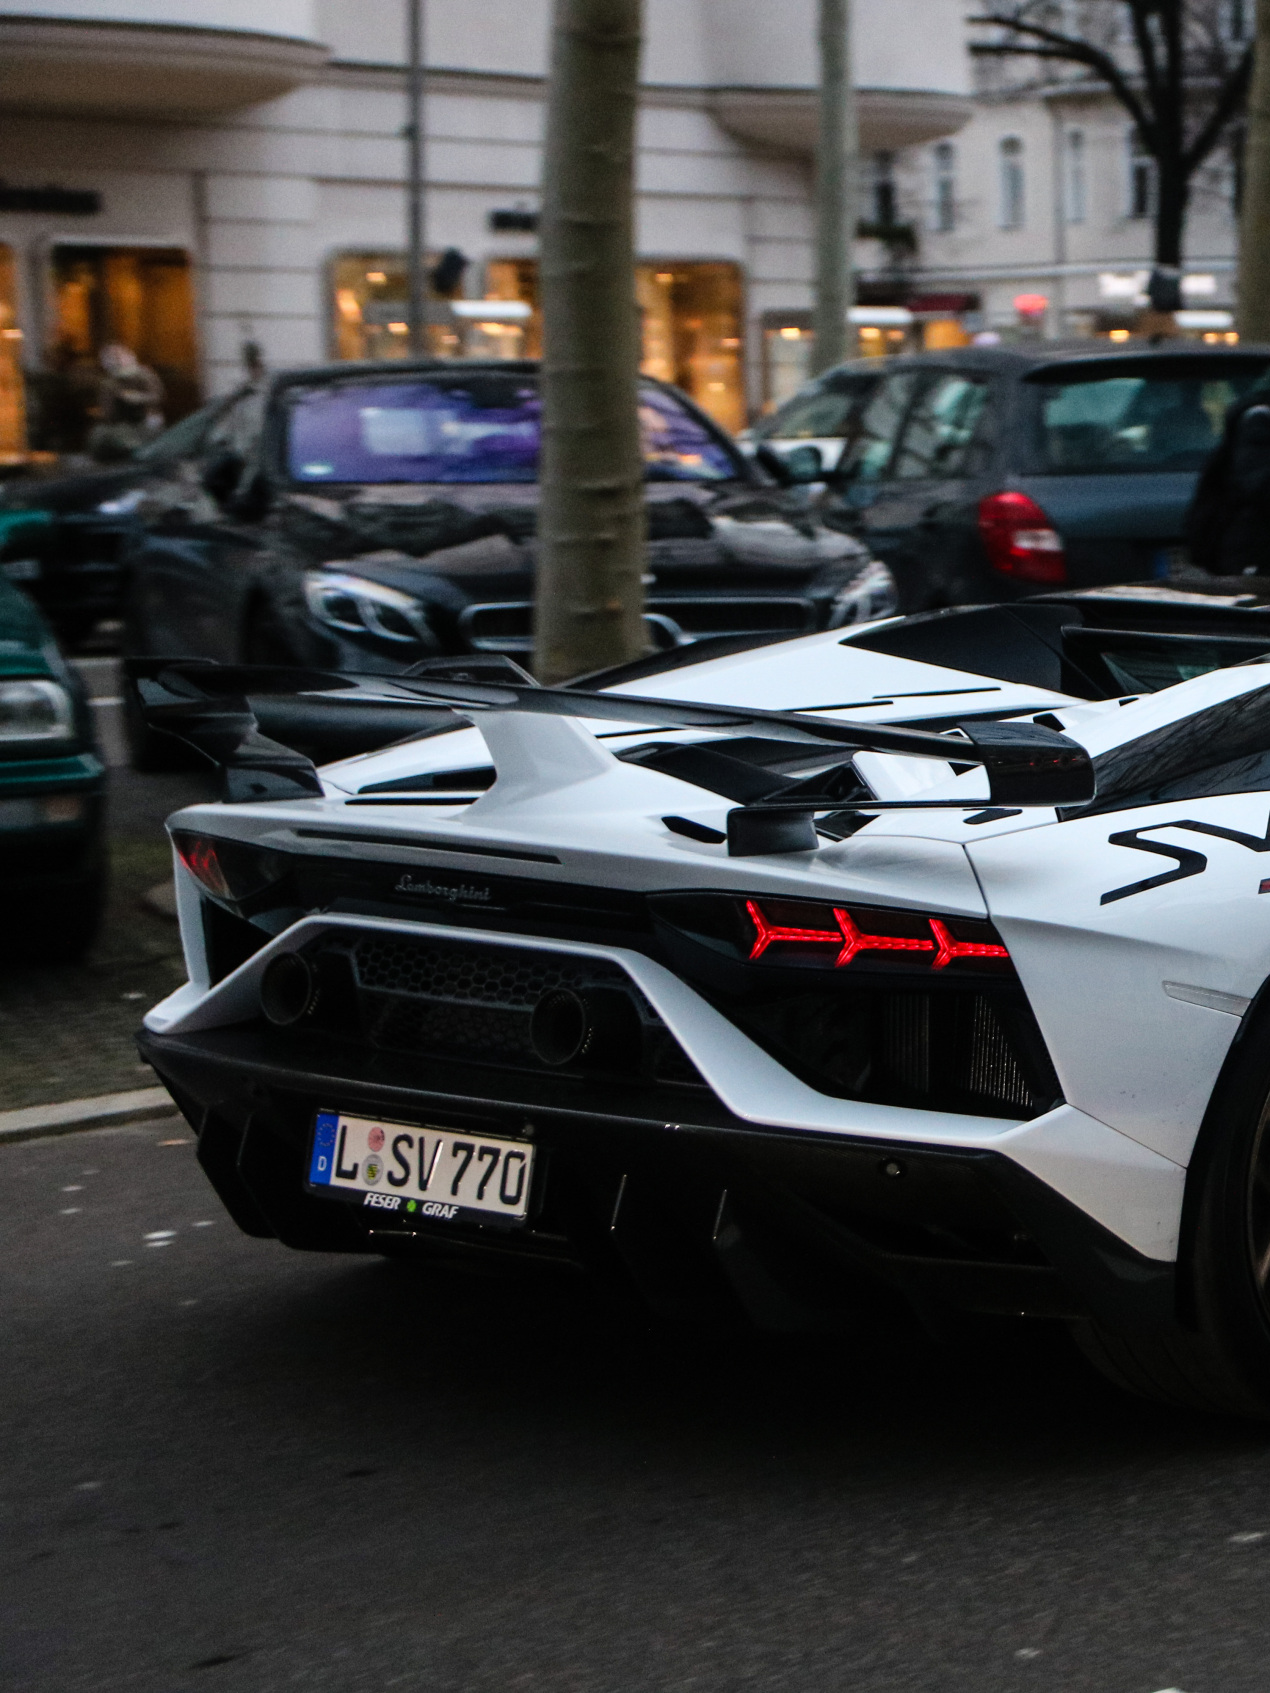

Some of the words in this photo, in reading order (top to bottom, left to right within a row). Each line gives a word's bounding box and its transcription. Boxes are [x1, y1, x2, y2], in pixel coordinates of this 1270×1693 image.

[394, 874, 491, 902] Lamborghini
[317, 1155, 328, 1171] D
[364, 1192, 402, 1211] FESER
[422, 1202, 459, 1219] GRAF
